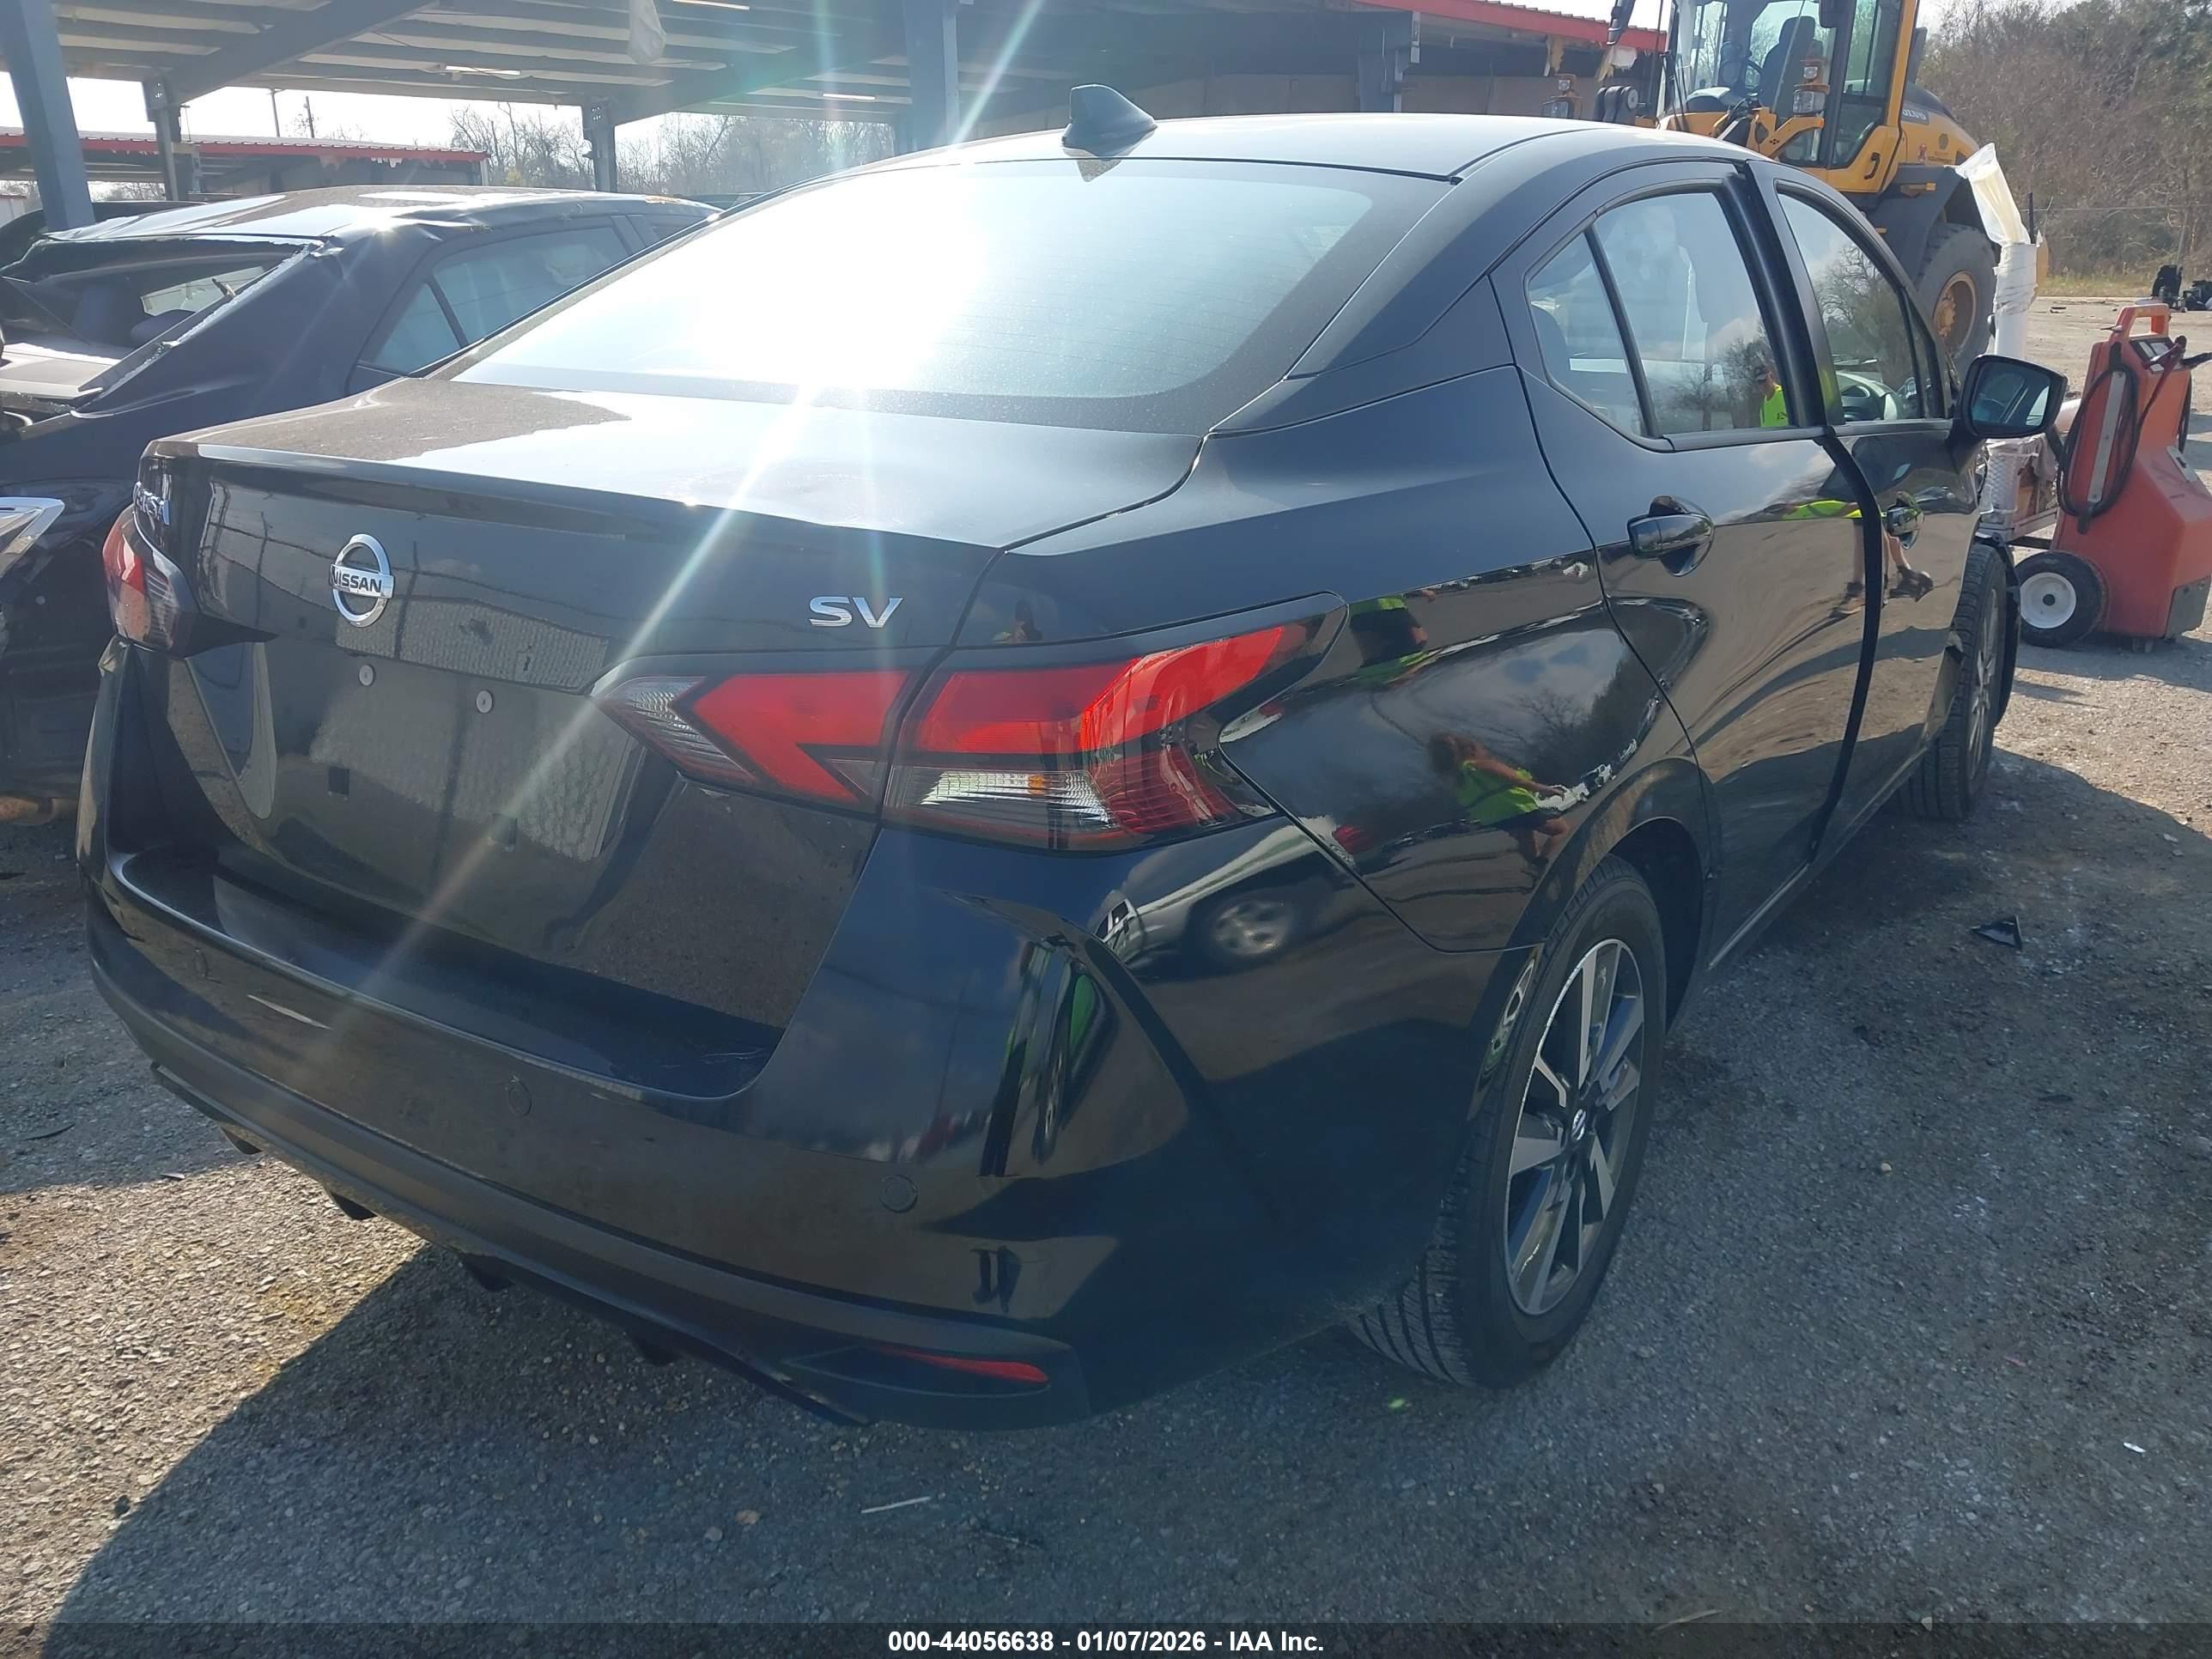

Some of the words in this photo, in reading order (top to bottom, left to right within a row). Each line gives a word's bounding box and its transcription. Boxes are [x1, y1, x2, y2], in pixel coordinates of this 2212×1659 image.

[1902, 109, 1927, 120] OLVO
[330, 565, 382, 593] NISSAN
[809, 596, 903, 628] SV
